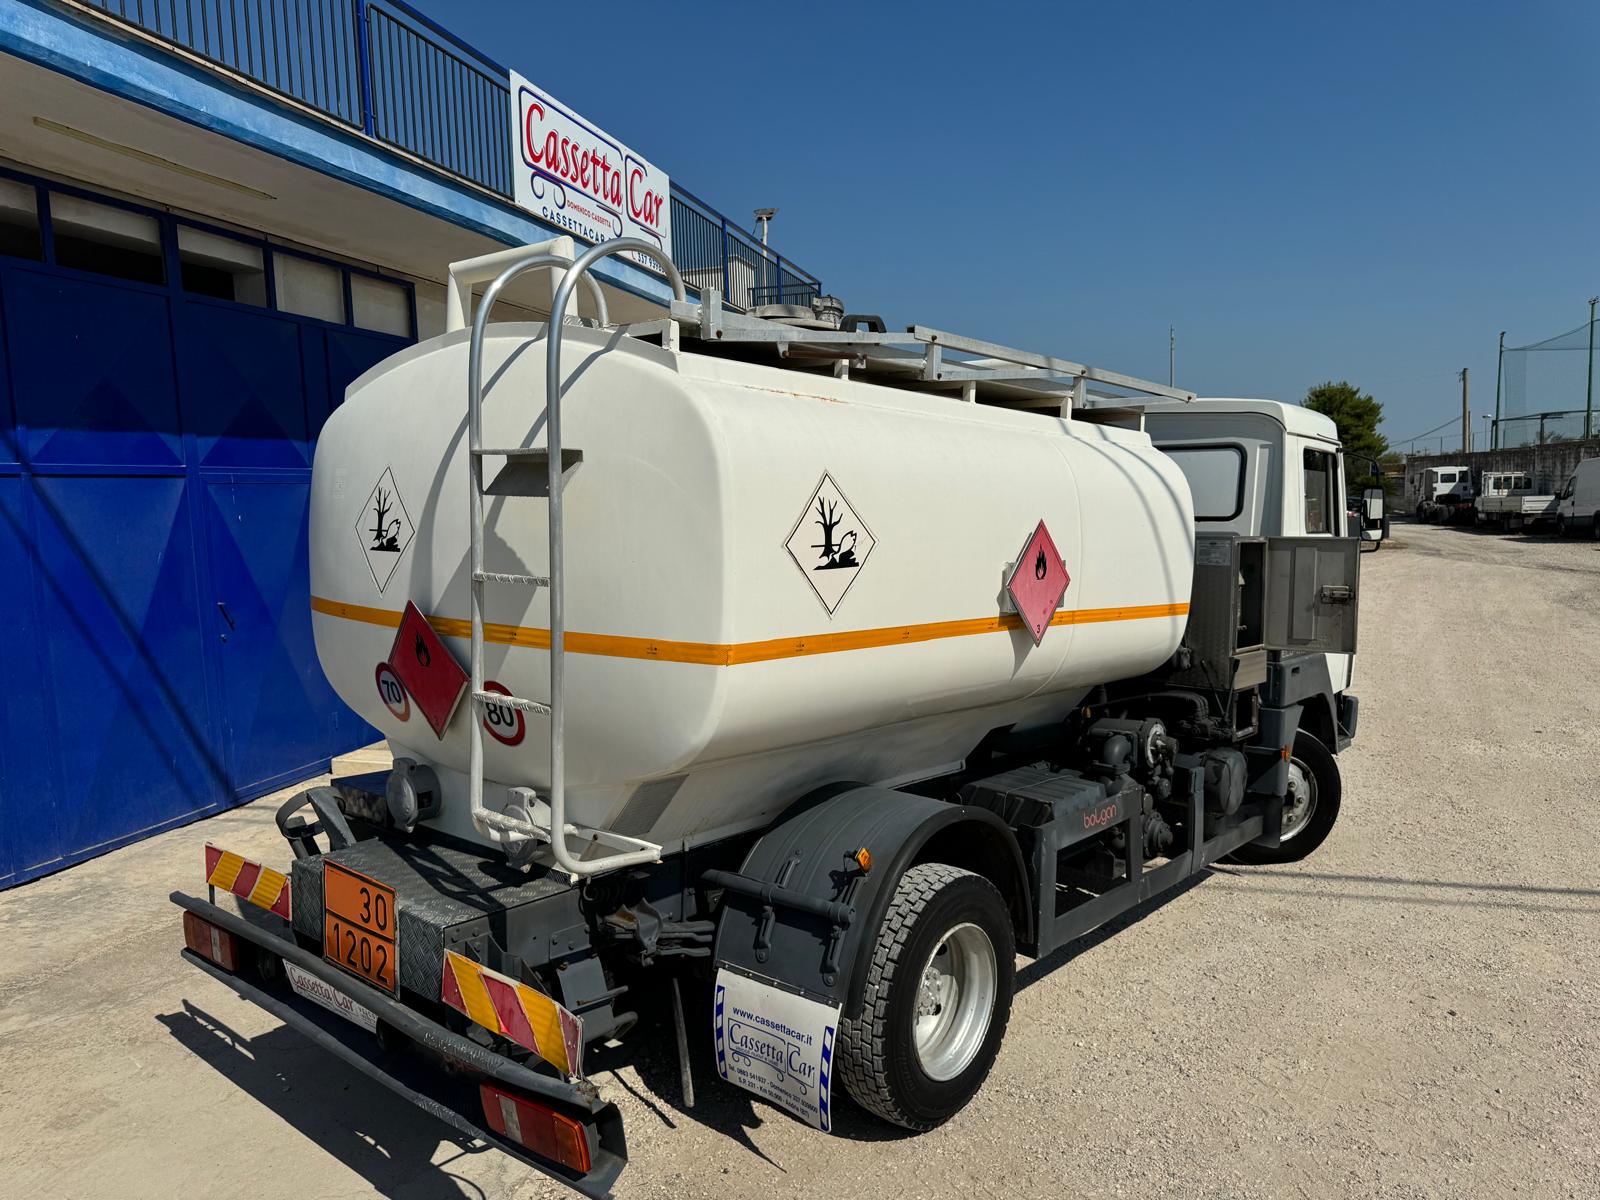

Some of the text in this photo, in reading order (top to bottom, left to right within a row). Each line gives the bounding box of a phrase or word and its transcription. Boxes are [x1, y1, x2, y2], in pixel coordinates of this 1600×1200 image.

[526, 102, 663, 228] Cassetta Car
[542, 206, 611, 244] CASSETTACAR
[591, 213, 611, 228] CASSETTA
[1036, 624, 1041, 634] 3
[381, 680, 401, 704] 70
[485, 700, 515, 728] 80
[359, 887, 388, 931] 30
[333, 922, 388, 984] 1202
[289, 966, 332, 1001] Cassetta
[333, 989, 354, 1012] Car
[732, 1007, 813, 1046] www.cassettacar.it
[729, 1023, 784, 1064] Cassetta
[788, 1050, 815, 1078] Car
